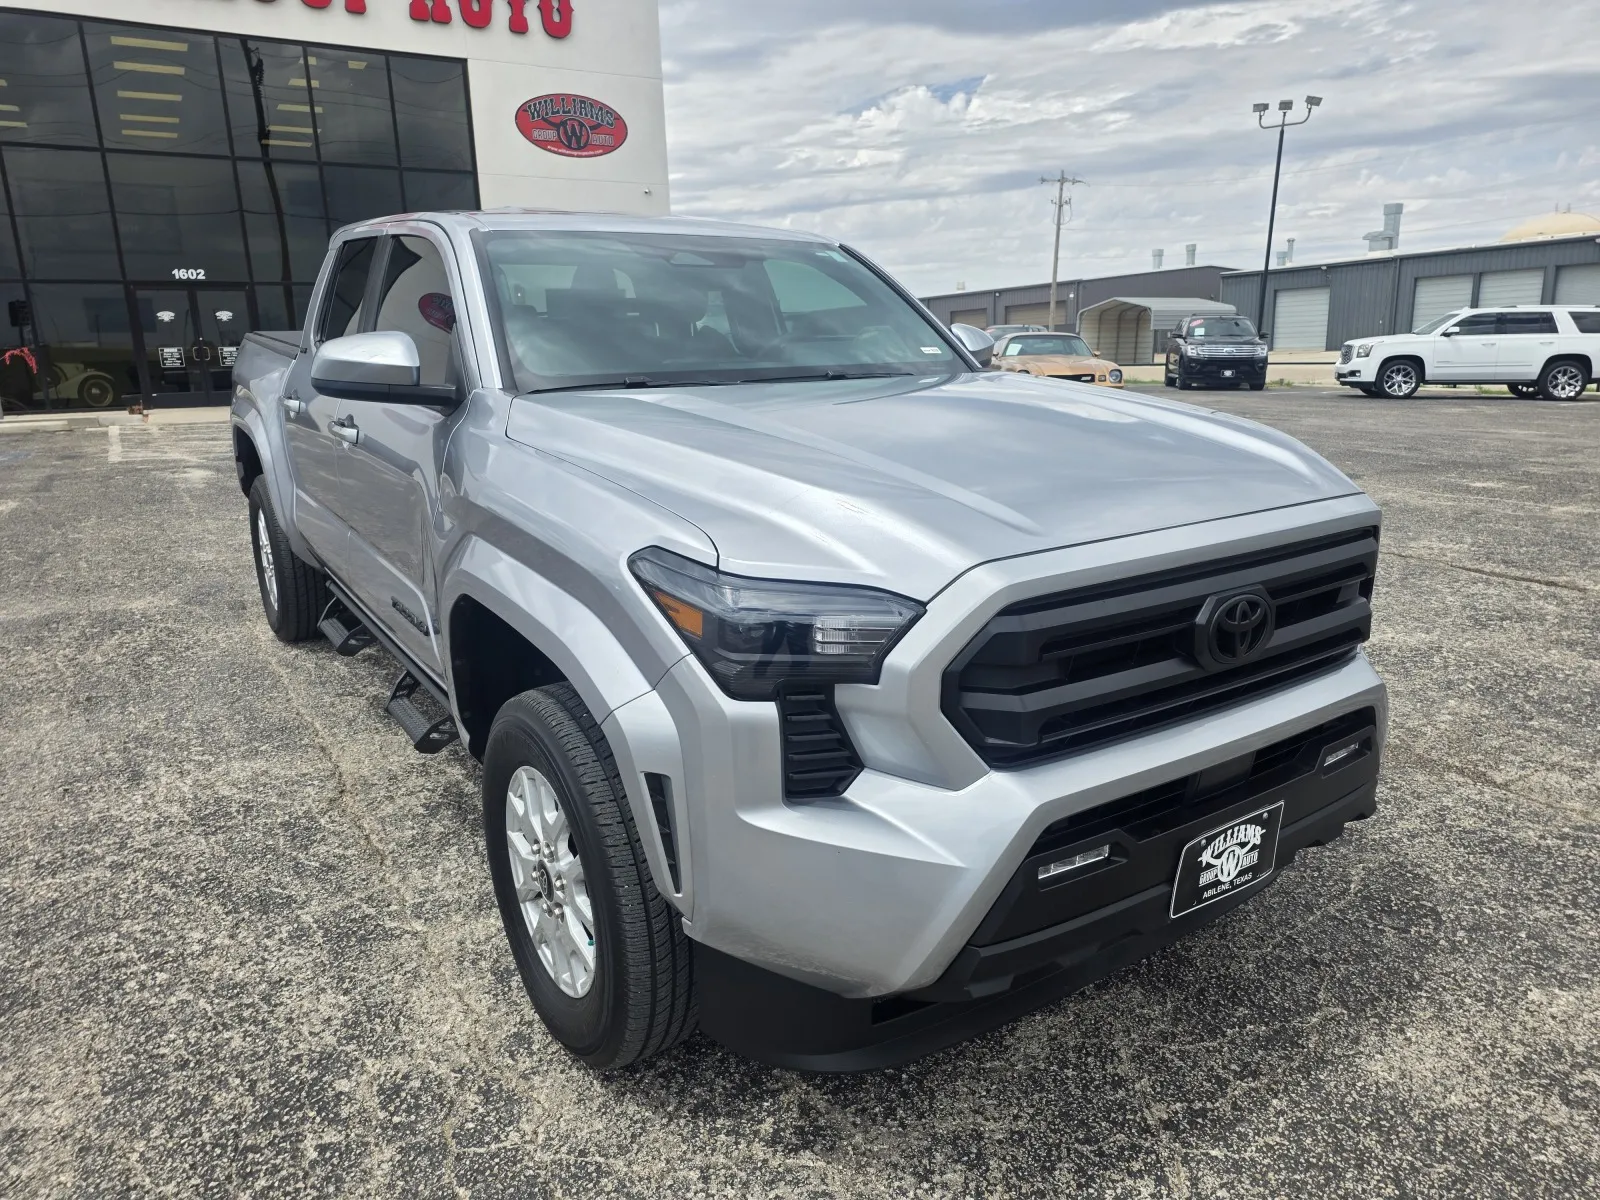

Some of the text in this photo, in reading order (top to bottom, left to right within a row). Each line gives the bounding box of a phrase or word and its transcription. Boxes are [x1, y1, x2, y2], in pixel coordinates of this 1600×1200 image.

[527, 97, 615, 129] WILLIAMS
[532, 128, 558, 141] GROUP
[591, 133, 615, 146] AUTO
[171, 268, 206, 280] 1602
[1201, 824, 1262, 868] WILLIAMS
[1242, 851, 1259, 868] AUTO
[1202, 872, 1253, 899] ABILENE, TEXAS
